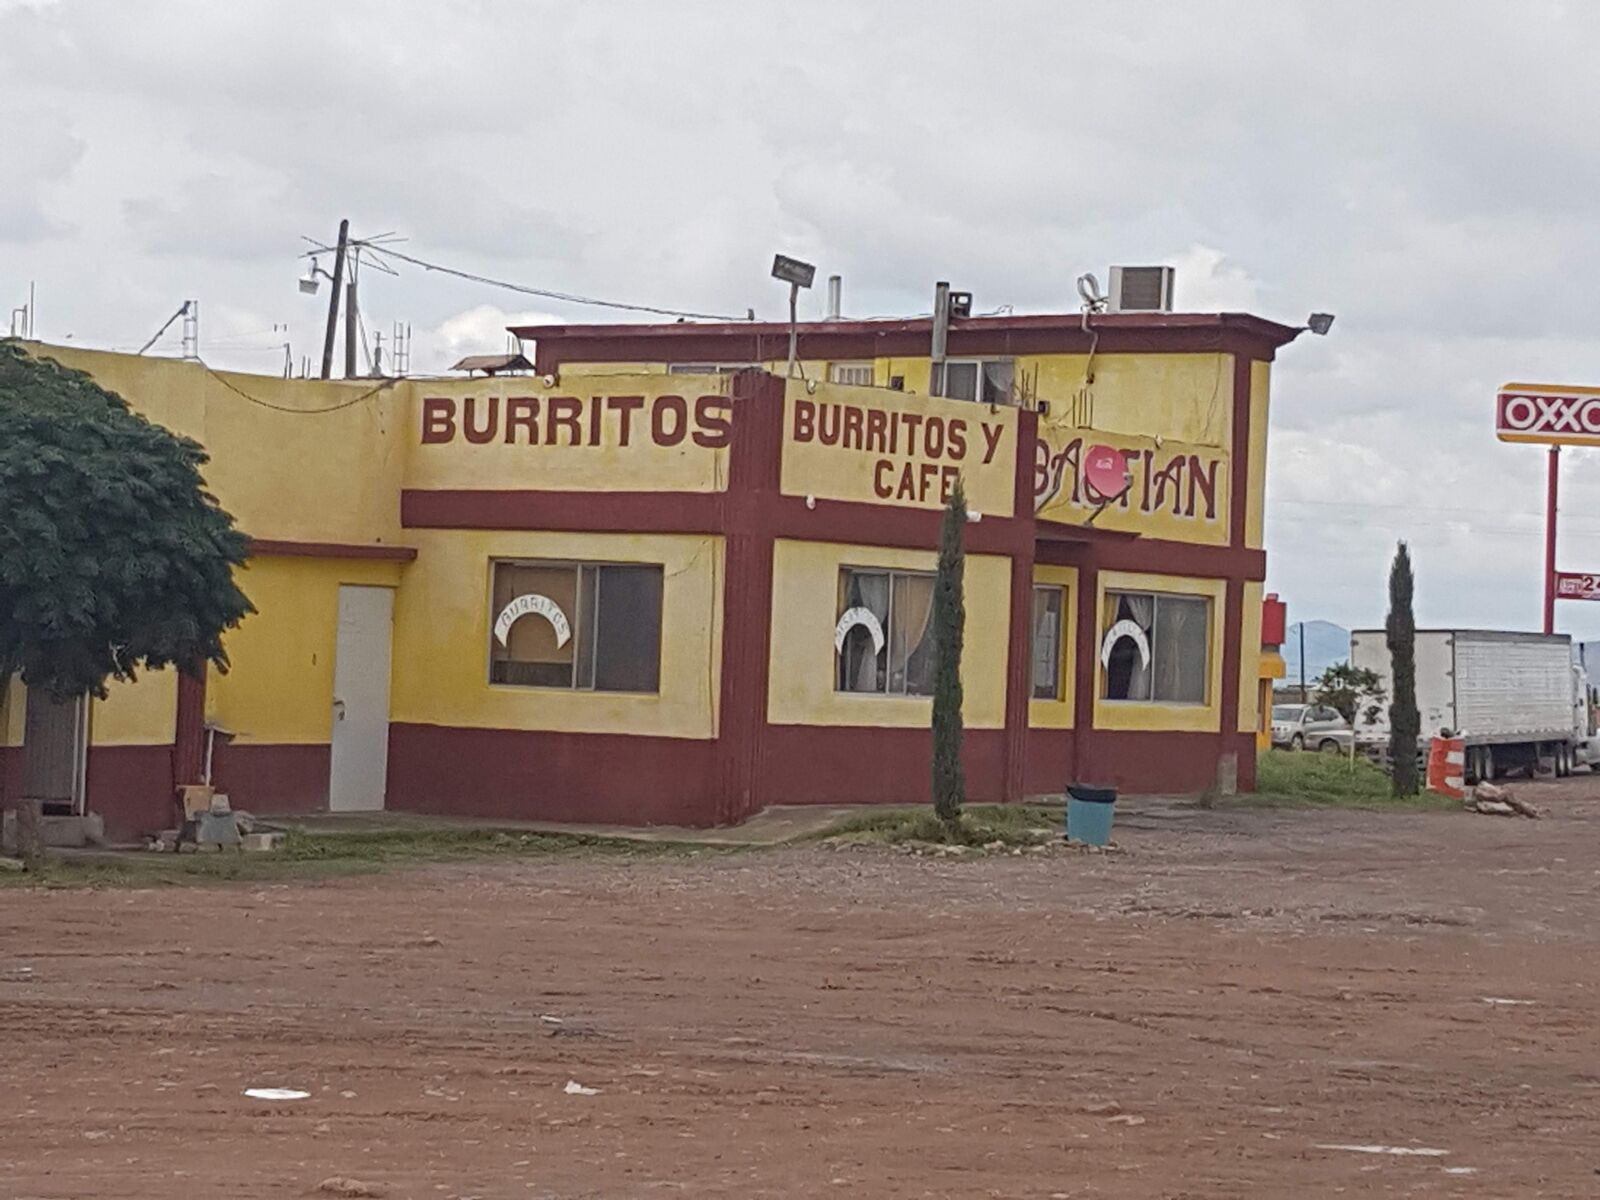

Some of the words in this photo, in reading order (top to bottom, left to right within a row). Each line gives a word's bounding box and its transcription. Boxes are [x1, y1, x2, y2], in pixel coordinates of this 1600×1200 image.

[421, 395, 733, 448] BURRITOS
[793, 400, 967, 460] BURRITOS
[981, 422, 1004, 464] Y
[1505, 397, 1600, 433] OXXO
[873, 459, 960, 504] CAFE
